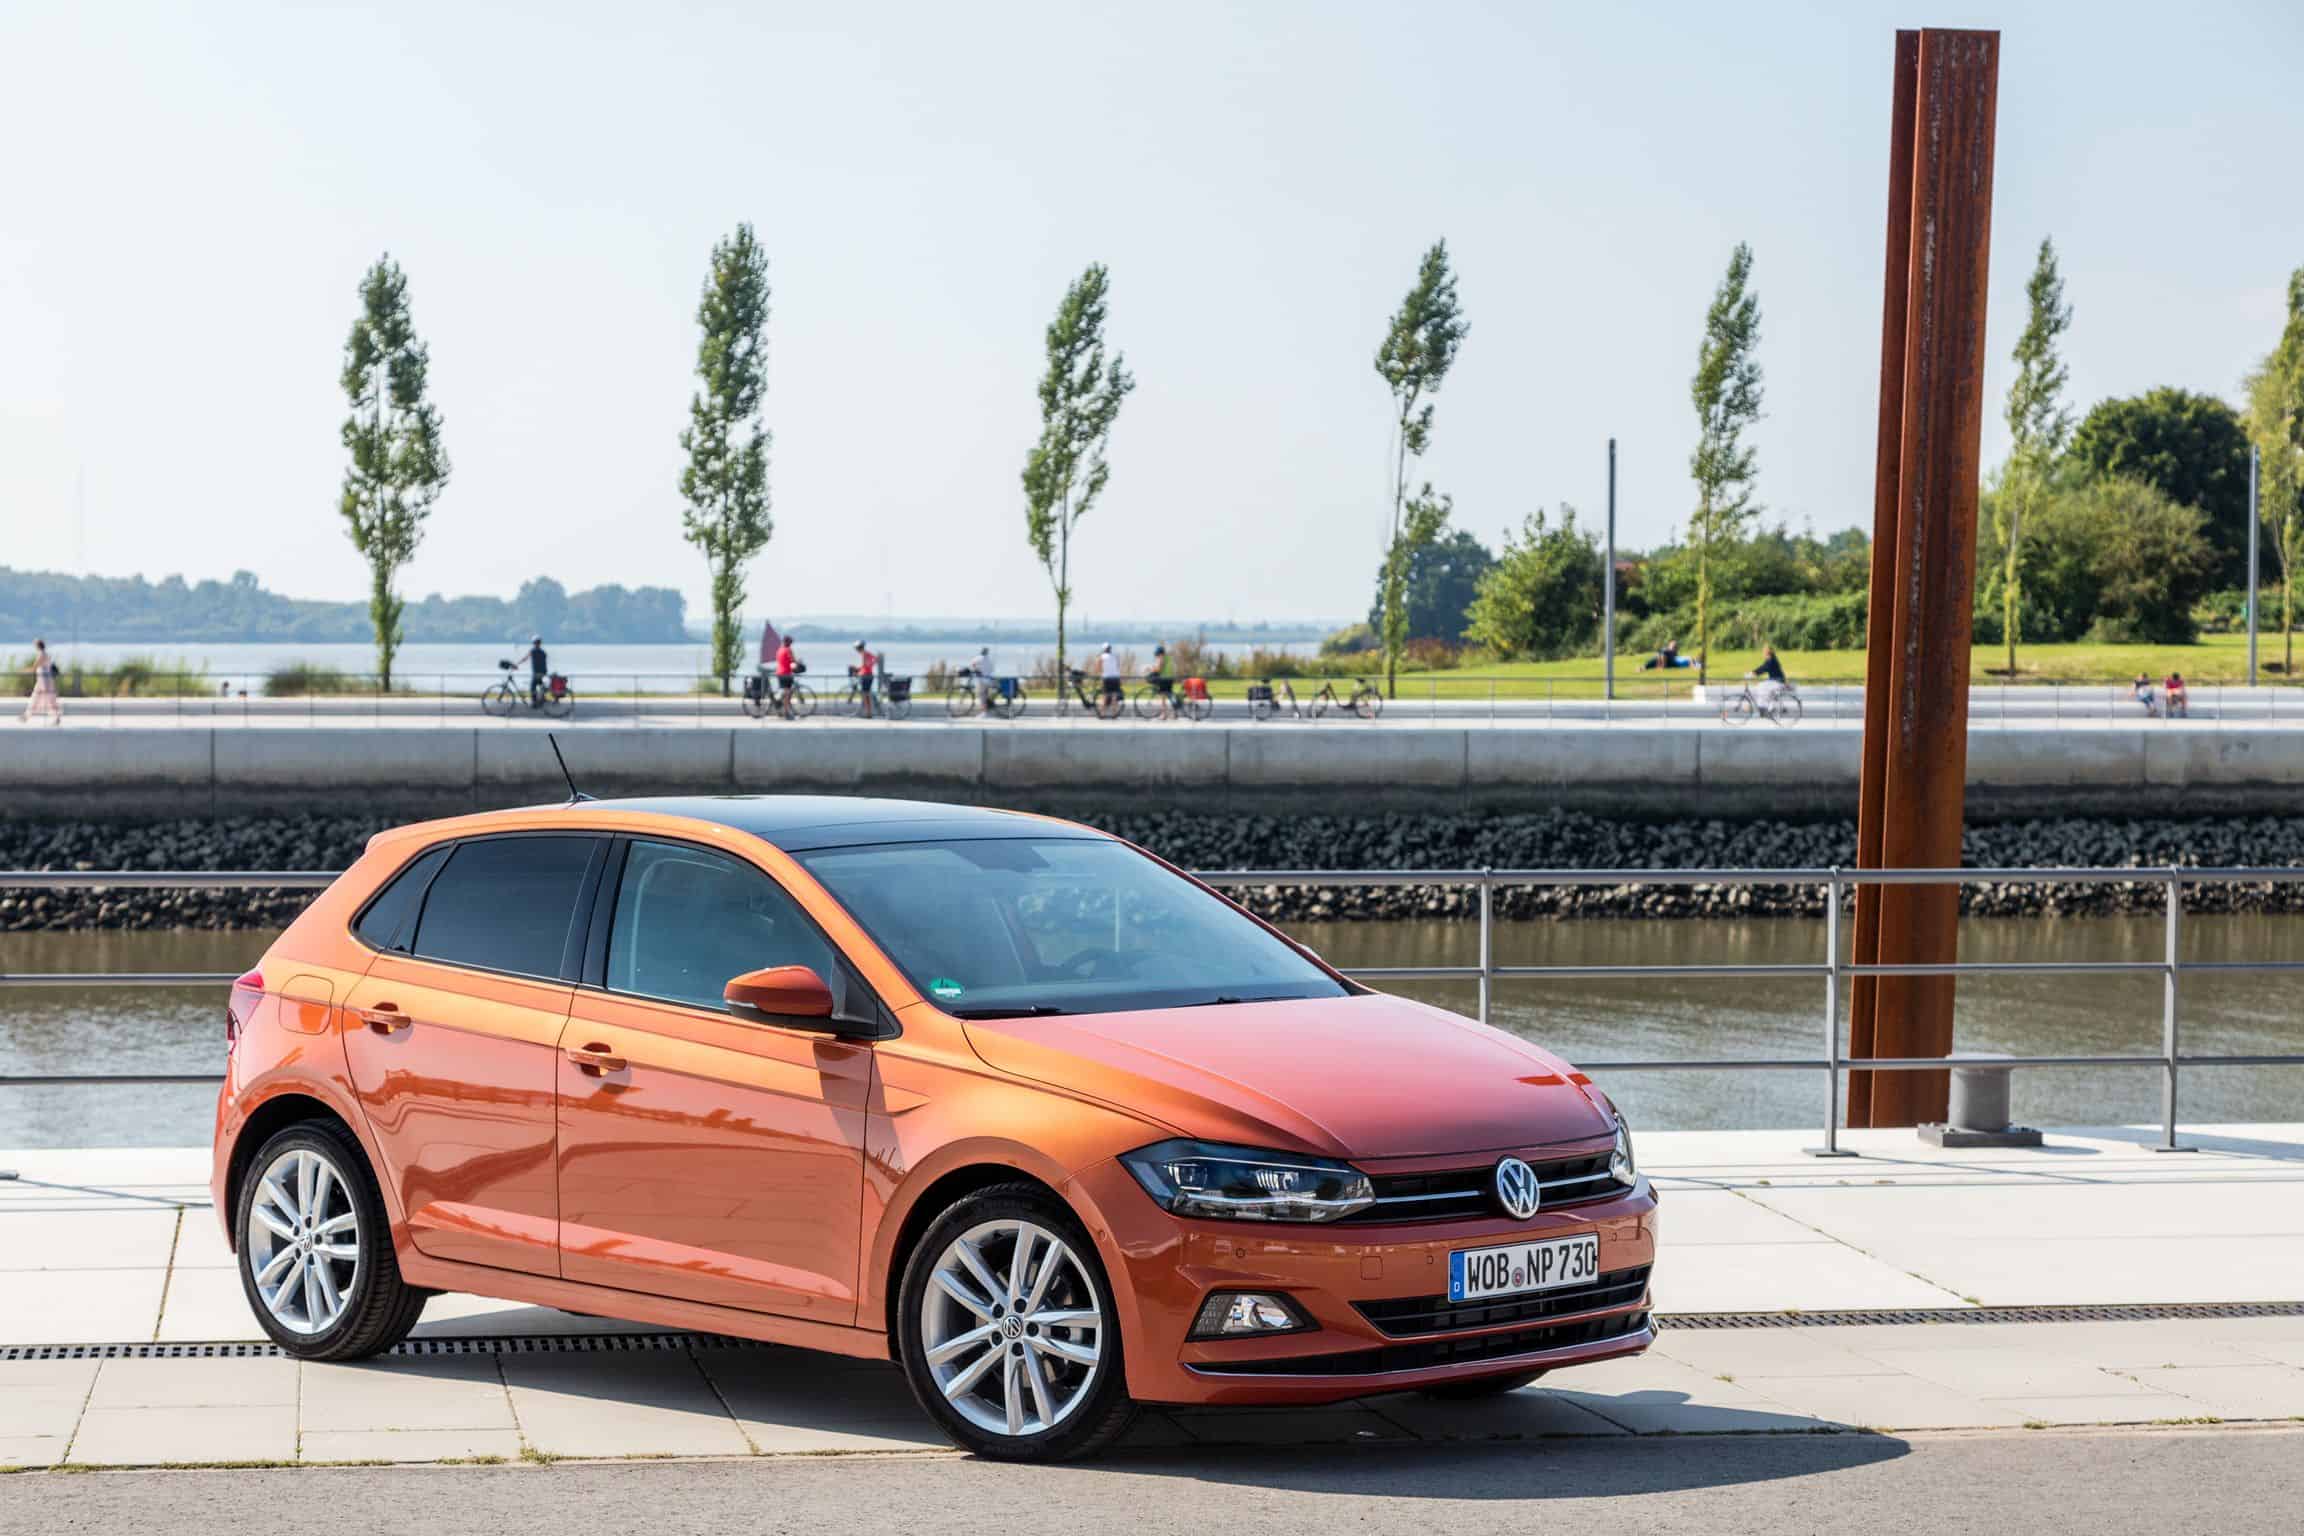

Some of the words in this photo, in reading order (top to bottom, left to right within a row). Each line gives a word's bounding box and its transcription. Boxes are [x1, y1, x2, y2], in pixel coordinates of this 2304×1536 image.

[1497, 1158, 1540, 1219] VW
[1453, 1281, 1461, 1293] D
[1467, 1253, 1509, 1293] WOB
[1527, 1247, 1554, 1286] NP
[1558, 1241, 1597, 1281] 730
